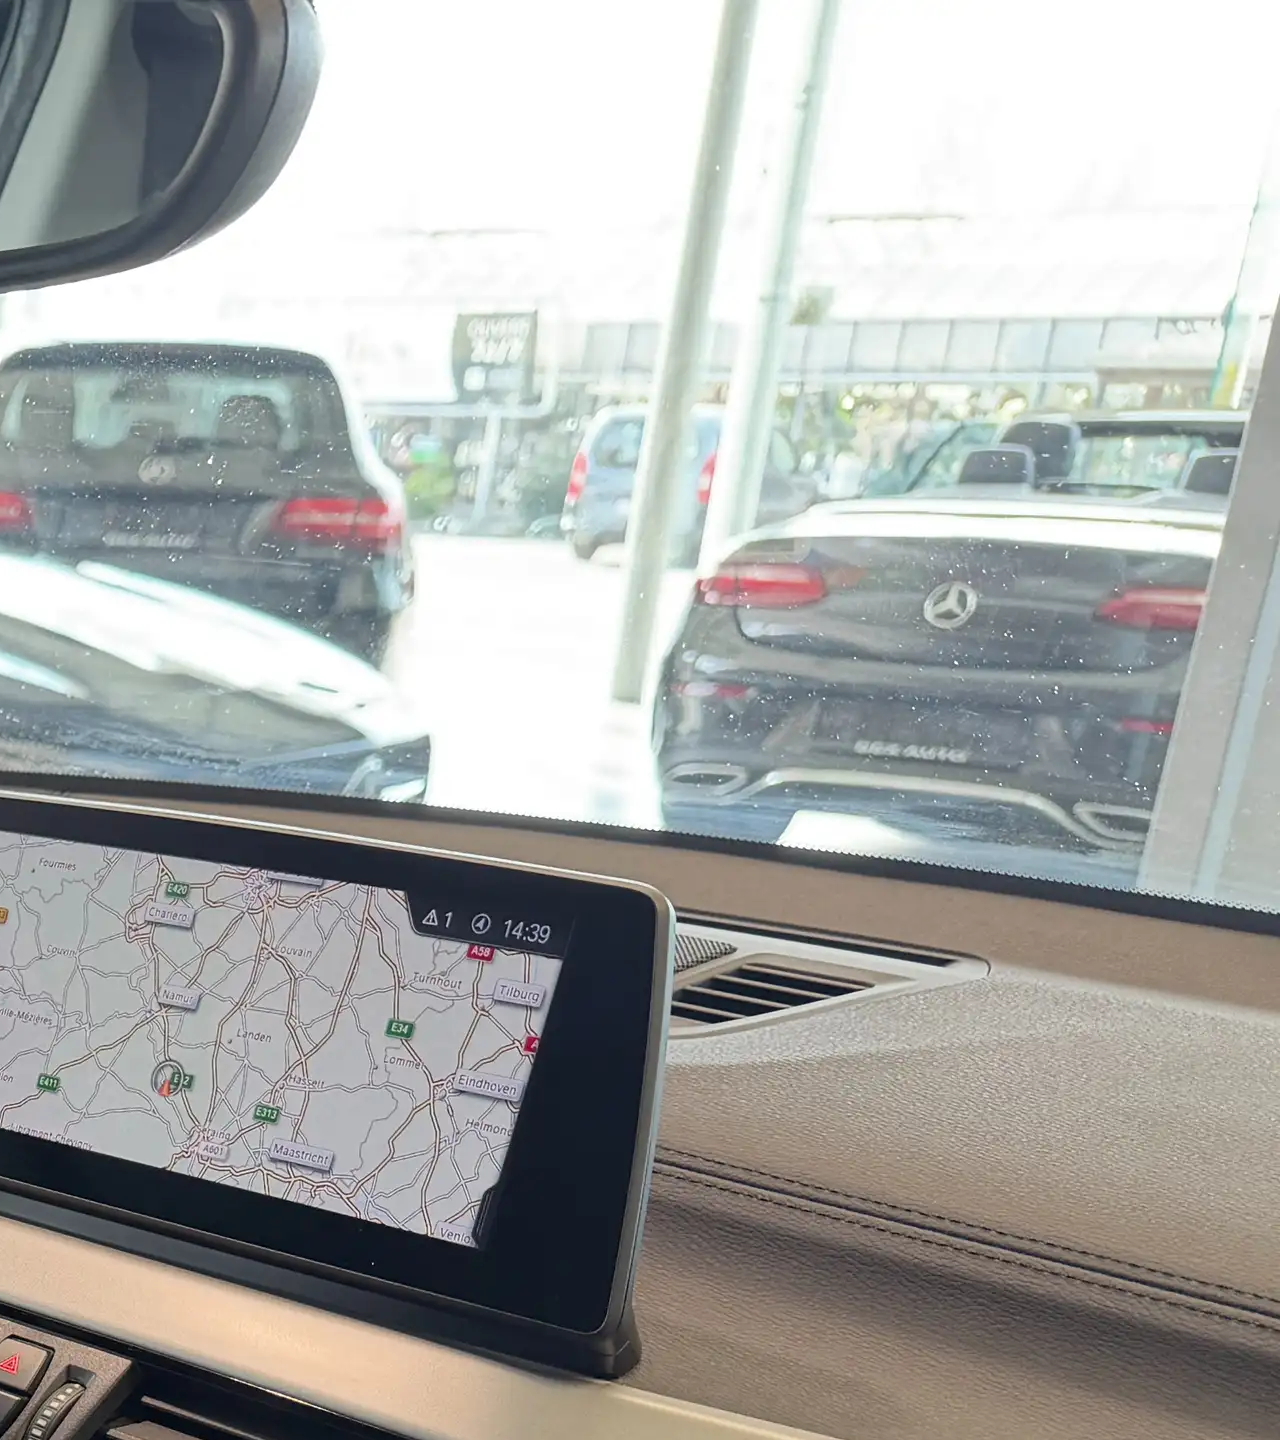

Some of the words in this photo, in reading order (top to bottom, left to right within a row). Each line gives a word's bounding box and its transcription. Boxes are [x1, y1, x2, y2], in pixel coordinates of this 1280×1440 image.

[39, 858, 77, 872] Fourmies
[167, 884, 187, 896] E420
[445, 912, 453, 928] 1
[504, 919, 551, 944] 14:39
[47, 944, 77, 957] Couvin
[471, 945, 491, 958] A58
[413, 971, 462, 990] Turnhout
[163, 988, 194, 1003] Namur
[499, 984, 540, 1003] Tilburg
[391, 1022, 409, 1035] E34
[236, 1029, 272, 1044] Landen
[40, 1076, 58, 1089] E411
[289, 1074, 325, 1088] Hasselt
[458, 1074, 517, 1096] Eindhoven
[255, 1106, 277, 1120] E313
[273, 1142, 329, 1165] Maastricht
[440, 1227, 471, 1244] Venlo
